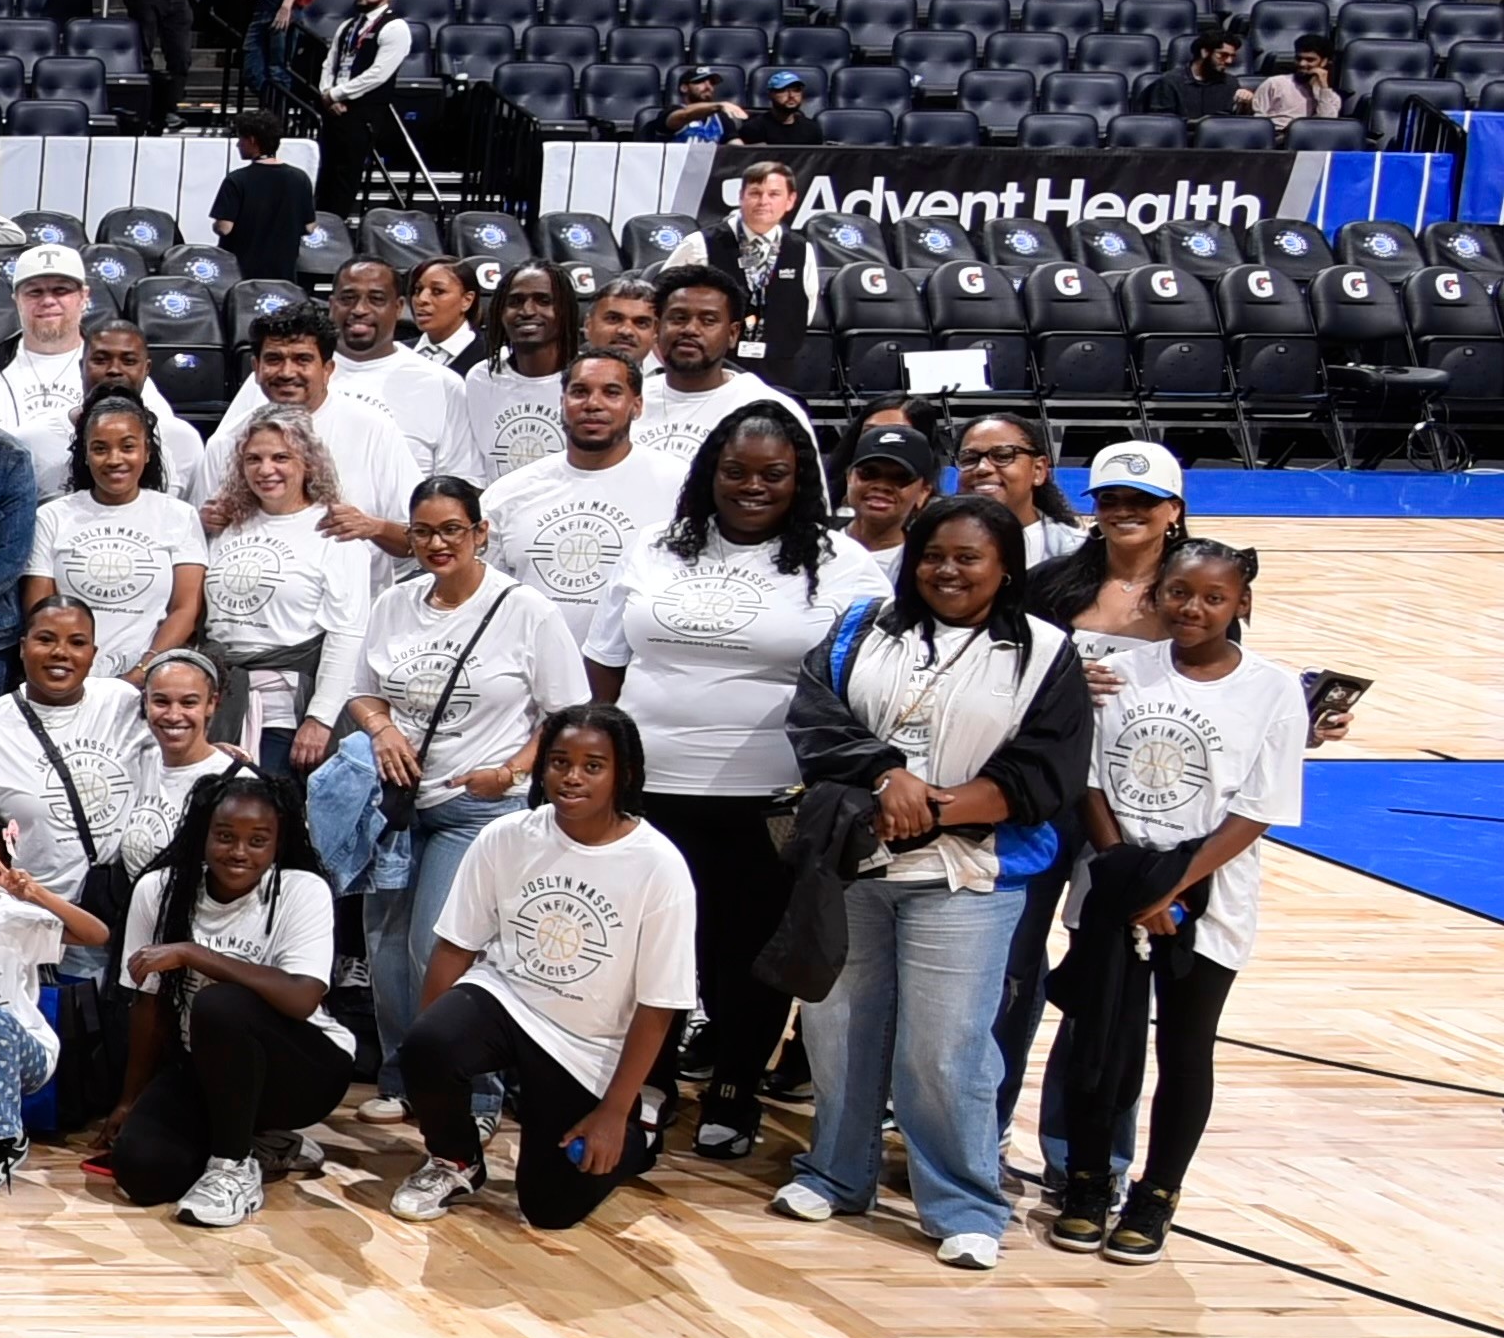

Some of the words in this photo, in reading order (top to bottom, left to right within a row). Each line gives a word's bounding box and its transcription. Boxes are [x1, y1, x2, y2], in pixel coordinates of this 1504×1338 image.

[791, 175, 1025, 230] Advent
[1034, 177, 1261, 234] Health
[37, 250, 61, 266] T
[476, 263, 502, 289] G
[570, 267, 595, 293] G
[861, 268, 887, 294] G
[959, 267, 985, 293] G
[1055, 269, 1081, 295] G
[1151, 270, 1178, 297] G
[1248, 271, 1273, 297] G
[1343, 272, 1368, 298] G
[1436, 274, 1461, 299] G
[495, 404, 531, 429] JOSLYN
[508, 424, 551, 441] INFINITE
[538, 501, 585, 527] JOSLYN
[591, 501, 634, 532] MASSEY
[553, 521, 608, 538] INFINITE
[548, 571, 600, 587] LEGACIES
[672, 568, 722, 580] JOSLYN
[216, 592, 259, 609] LEGACIES
[1121, 703, 1174, 725] JOSLYN
[1182, 705, 1223, 755] MASSEY
[1133, 726, 1195, 754] INFINITE
[1118, 779, 1177, 804] LEGACIES
[521, 877, 573, 897] JOSLYN
[575, 880, 623, 930] MASSEY
[537, 901, 592, 930] INFINITE
